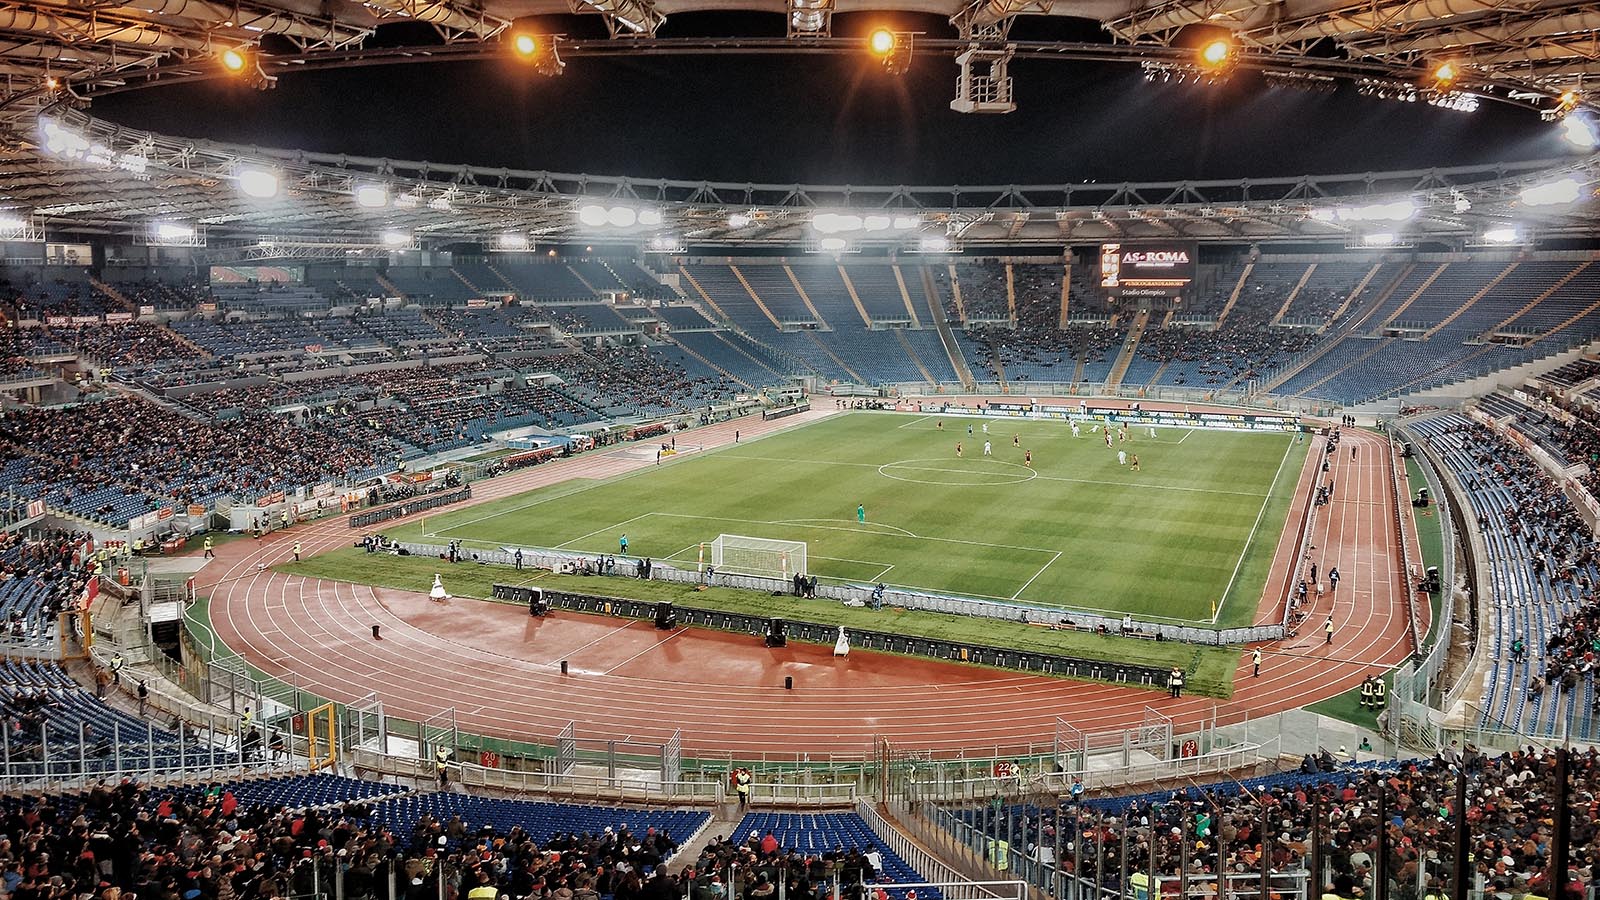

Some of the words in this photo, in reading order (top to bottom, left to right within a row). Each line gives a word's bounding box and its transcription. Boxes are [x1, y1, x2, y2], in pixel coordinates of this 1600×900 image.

[1122, 252, 1141, 261] AS
[1145, 252, 1189, 261] ROMA
[1186, 740, 1195, 750] 23
[485, 751, 495, 761] 20
[998, 762, 1010, 771] 22
